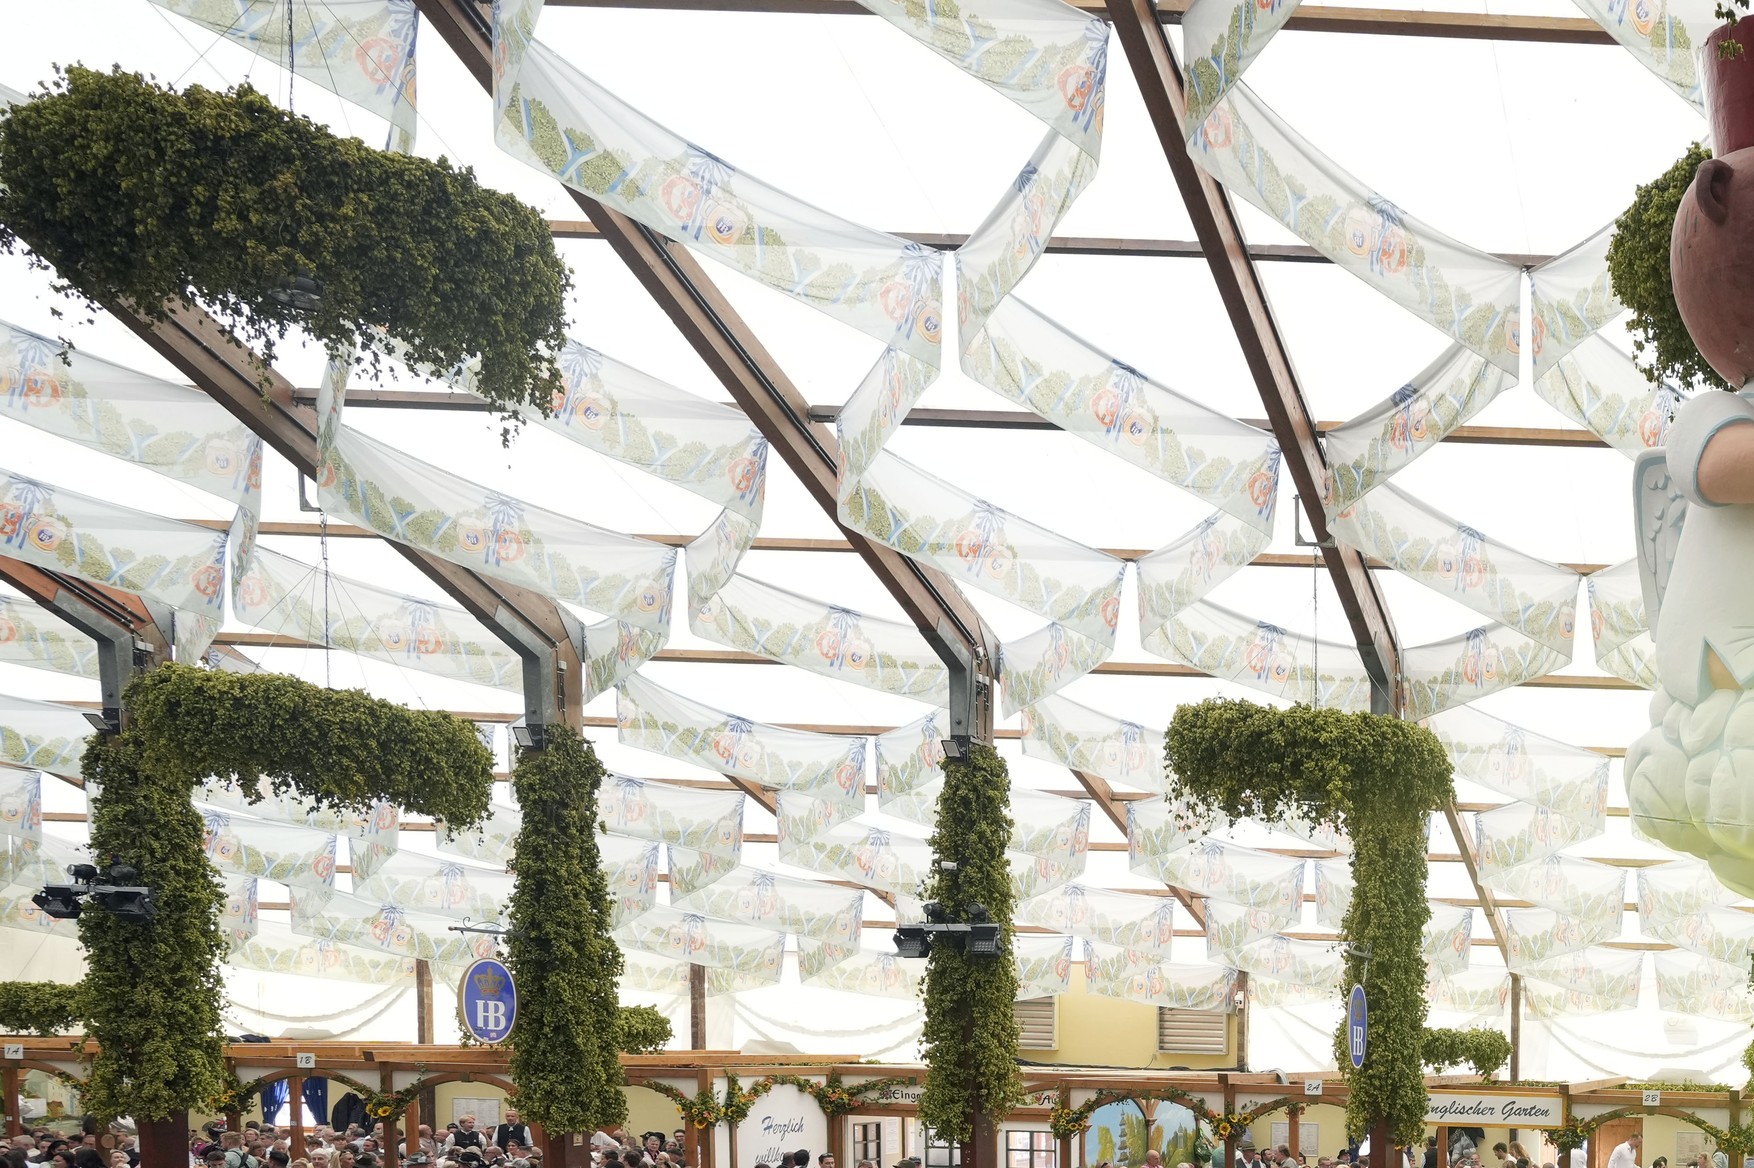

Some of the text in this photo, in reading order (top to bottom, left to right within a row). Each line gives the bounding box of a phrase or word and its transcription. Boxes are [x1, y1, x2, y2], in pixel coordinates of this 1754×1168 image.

[475, 999, 506, 1030] HB
[1353, 1026, 1363, 1055] HB
[1306, 1083, 1320, 1092] 2A
[1644, 1094, 1658, 1103] 2B
[1428, 1098, 1550, 1121] nglischer Garten
[761, 1115, 805, 1142] Herzlich
